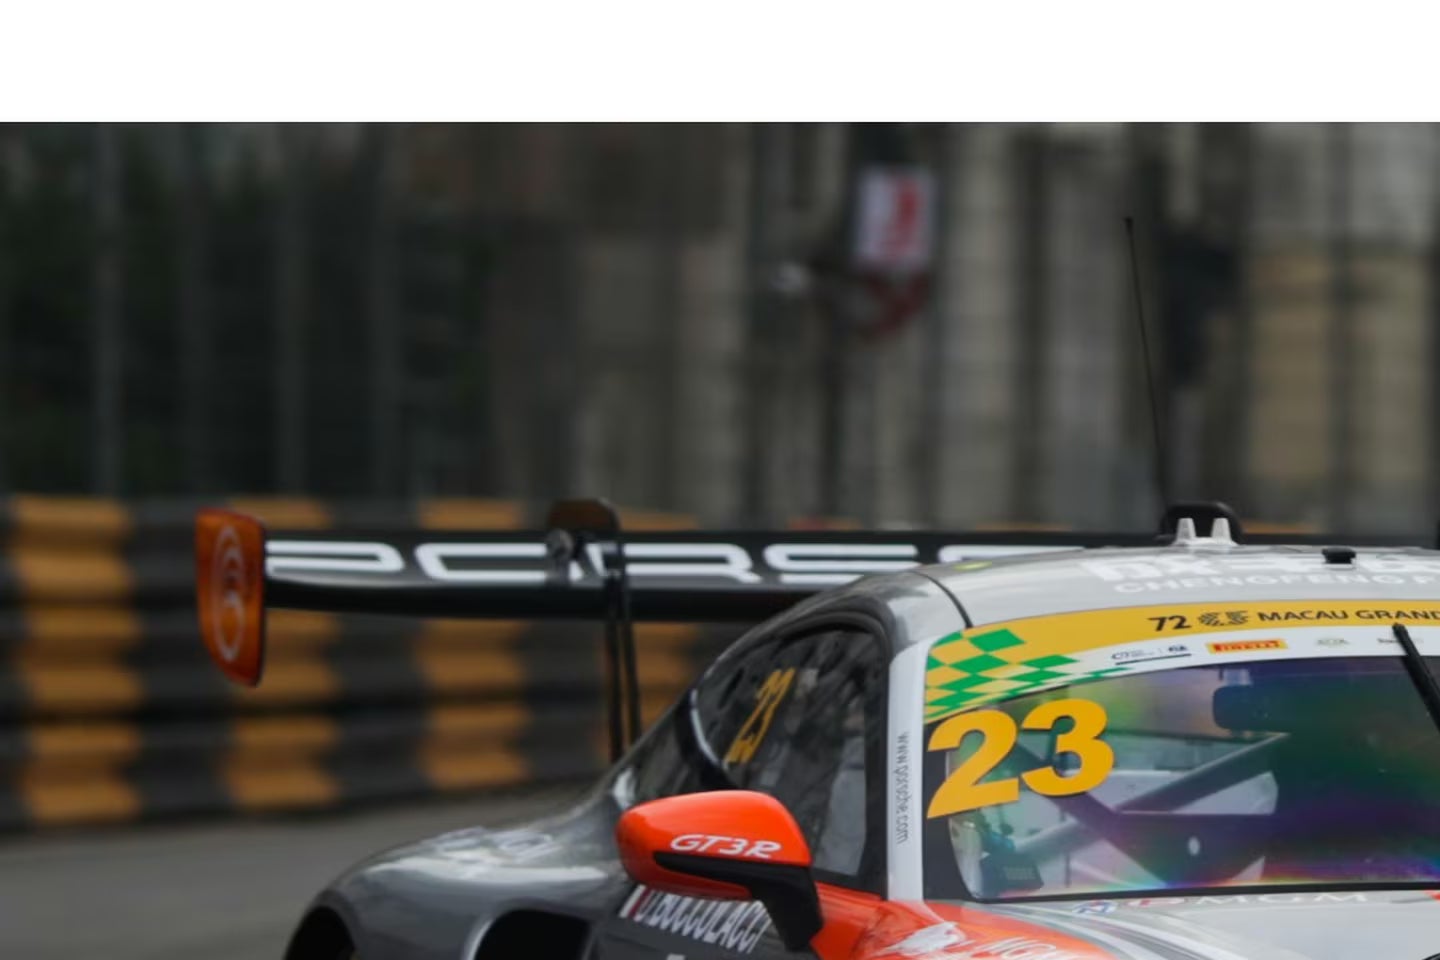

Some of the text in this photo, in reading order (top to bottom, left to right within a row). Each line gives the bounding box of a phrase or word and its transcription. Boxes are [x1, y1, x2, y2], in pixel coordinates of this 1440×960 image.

[1148, 615, 1191, 631] 72
[1257, 610, 1349, 622] MACAU
[893, 731, 912, 846] www.porsche.com
[926, 697, 1115, 819] 23
